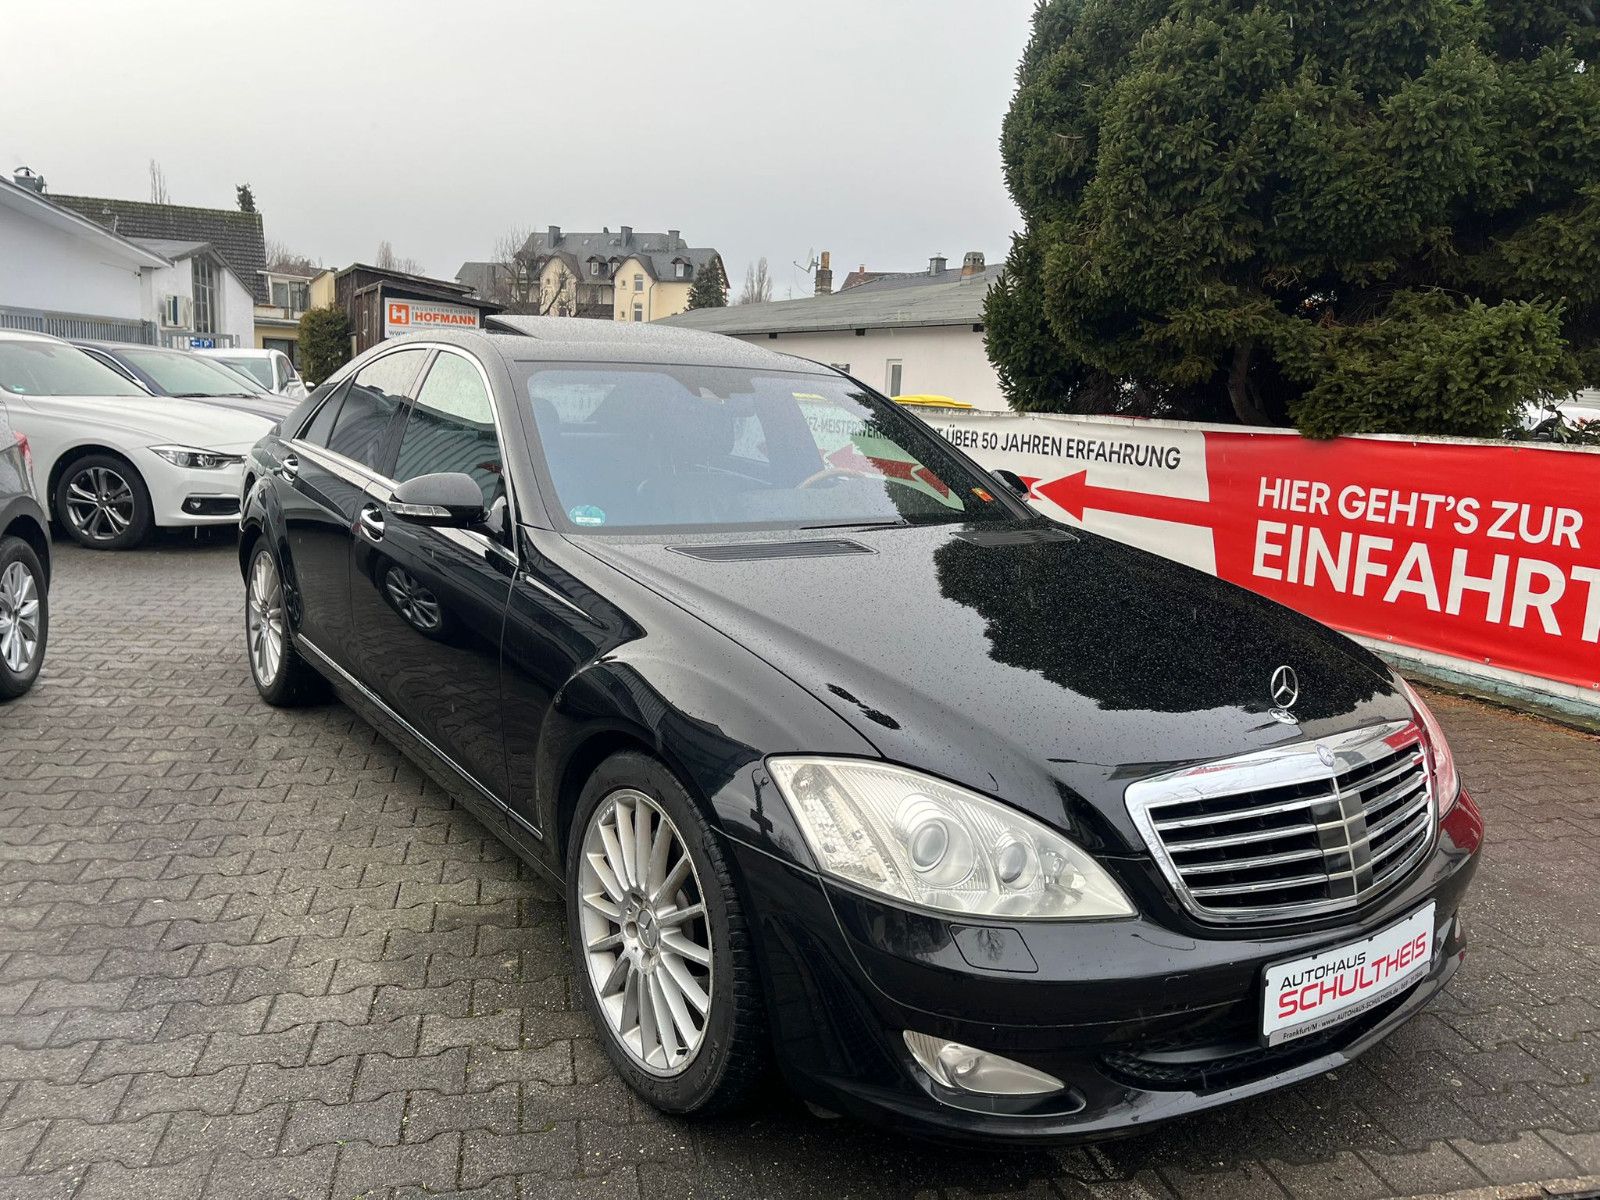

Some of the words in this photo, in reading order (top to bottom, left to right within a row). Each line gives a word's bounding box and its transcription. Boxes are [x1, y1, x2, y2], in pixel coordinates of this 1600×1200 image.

[414, 312, 476, 325] HOFMANN
[946, 424, 978, 448] ÜBER
[981, 432, 998, 450] 50
[1001, 434, 1062, 457] JAHREN
[1066, 438, 1181, 470] ERFAHRUNG
[1257, 476, 1331, 515] HIER
[1337, 485, 1480, 535] GEHT’S
[1486, 501, 1583, 549] ZUR
[1252, 519, 1600, 644] EINFAHRT
[1278, 932, 1427, 1019] SCHULTHEIS
[1280, 952, 1366, 991] AUTOHAUS
